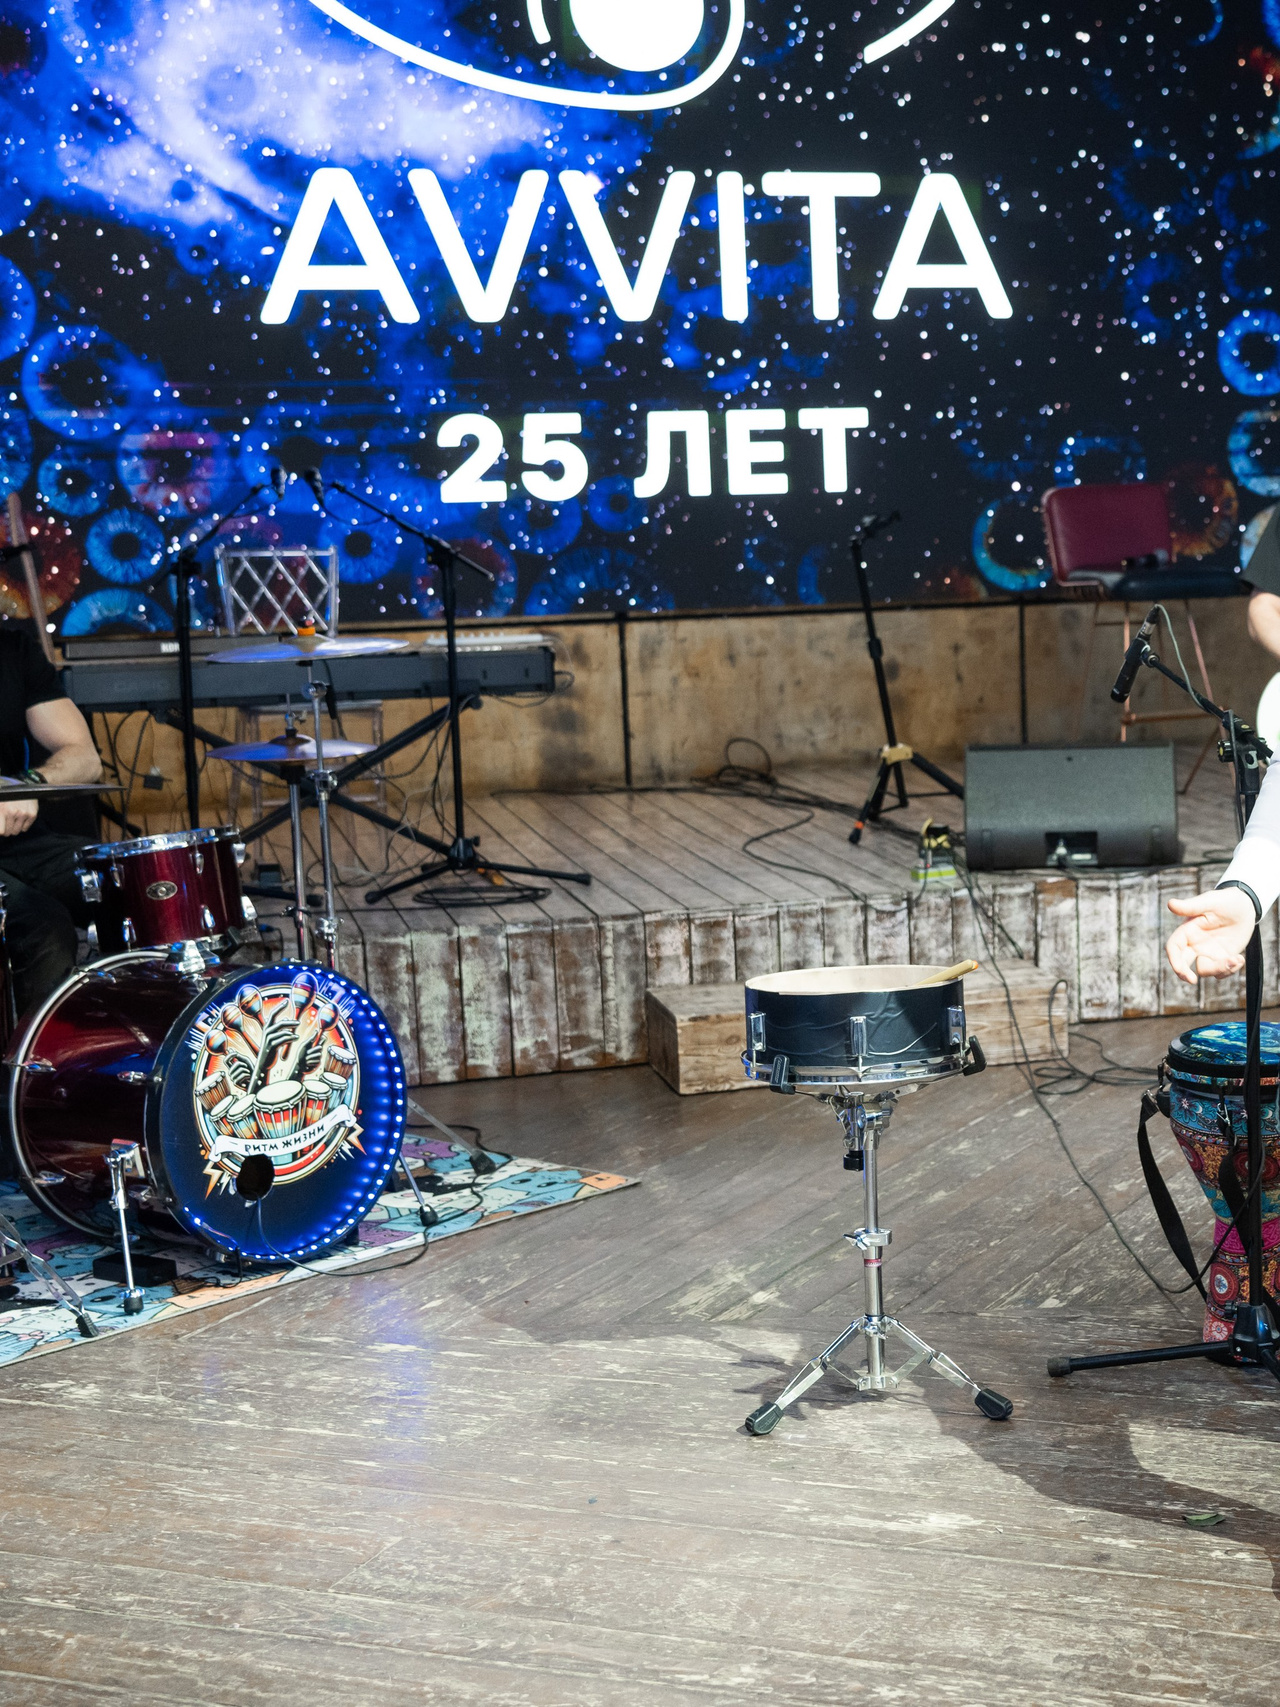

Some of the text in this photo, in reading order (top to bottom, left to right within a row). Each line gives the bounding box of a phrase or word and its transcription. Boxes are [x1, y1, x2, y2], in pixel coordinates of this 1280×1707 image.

[260, 168, 1013, 324] AVVITA
[437, 407, 869, 503] 25 ЛЕТ
[160, 642, 180, 653] KOR
[245, 1124, 324, 1152] РИТМ ЖИЗНИ
